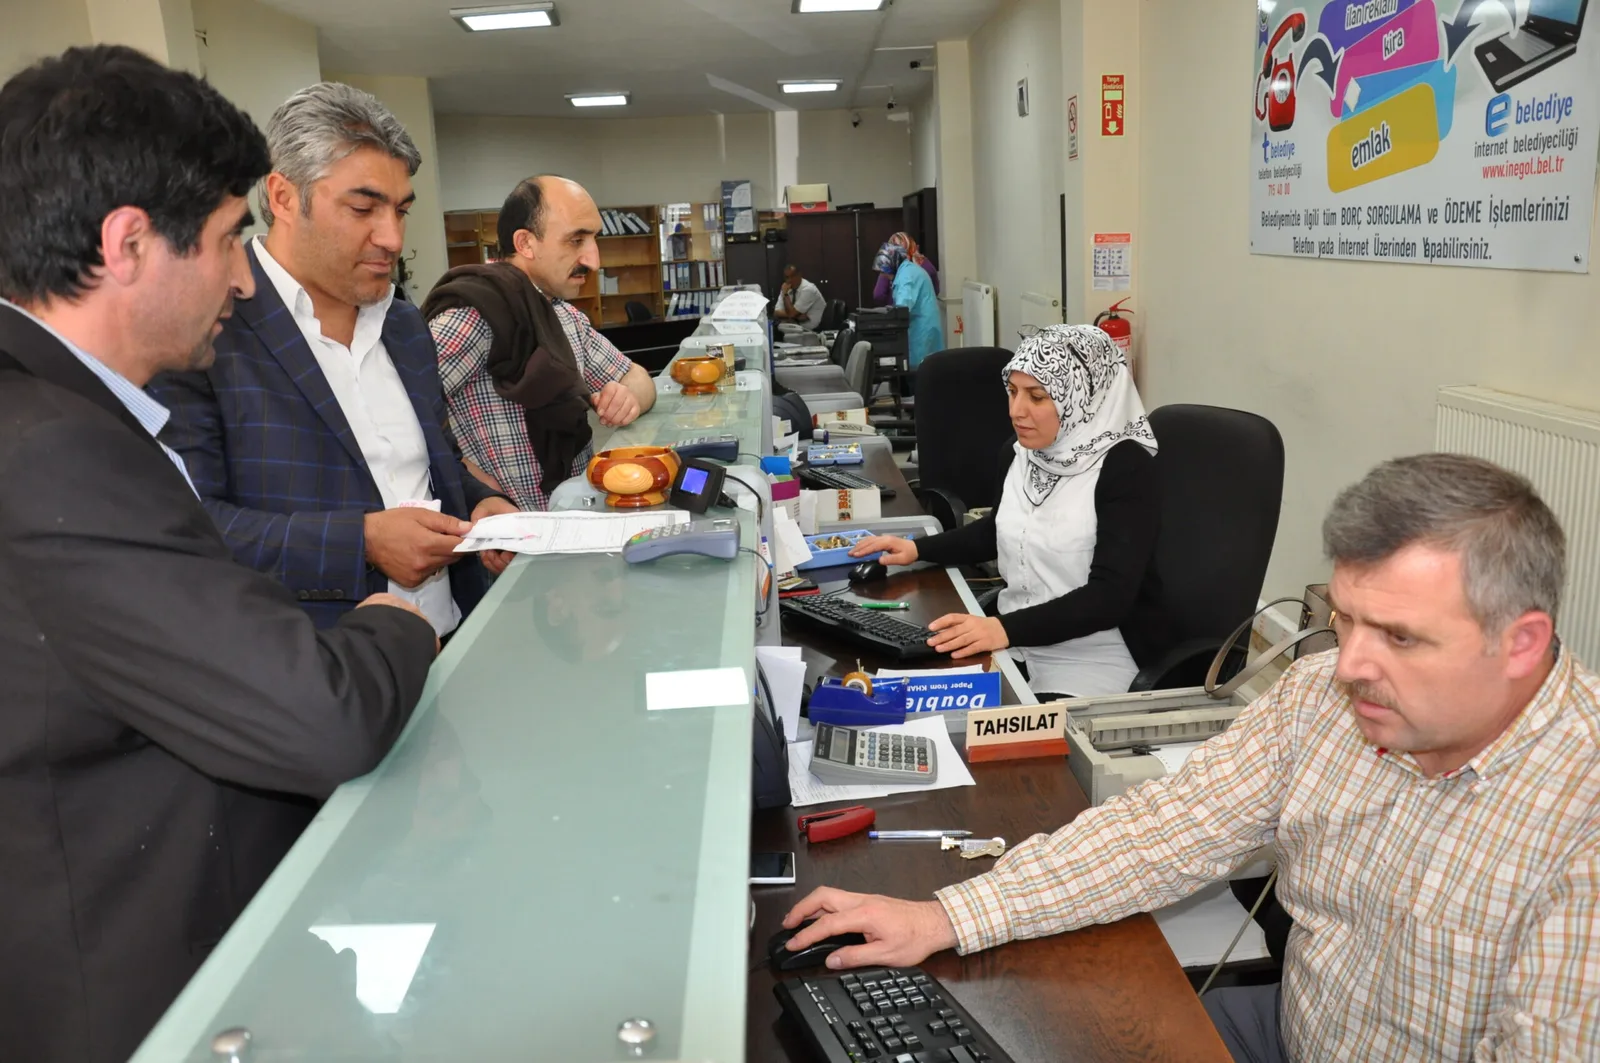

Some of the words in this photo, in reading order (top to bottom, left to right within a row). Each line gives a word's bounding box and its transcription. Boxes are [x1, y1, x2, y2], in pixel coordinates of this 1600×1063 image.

[1346, 5, 1362, 28] ilan
[1363, 0, 1398, 24] reklam
[1384, 30, 1404, 58] kira
[1485, 92, 1512, 138] e
[1515, 92, 1573, 125] belediye
[1270, 140, 1295, 160] belediye
[1352, 121, 1391, 169] emlak
[1474, 138, 1508, 158] internet
[1513, 126, 1579, 155] belediyeciliği
[1482, 155, 1564, 180] www.inegol.bel.tr
[1261, 209, 1301, 231] Belediyemizle
[1304, 208, 1320, 231] ilgili
[1323, 208, 1337, 226] tüm
[1341, 206, 1362, 230] BORÇ
[1366, 203, 1422, 226] SORGULAMA
[1427, 207, 1438, 224] ve
[1444, 197, 1482, 224] ÖDEME
[1488, 194, 1570, 229] İşlemlerinizi
[1293, 236, 1315, 254] Telefon
[1318, 237, 1334, 258] yada
[1338, 232, 1369, 256] İnternet
[1374, 233, 1417, 258] Üzerinden
[1422, 236, 1492, 263] Yapabilirsiniz.
[950, 682, 973, 690] Paper
[905, 693, 987, 713] Double
[974, 712, 1059, 736] TAHSILAT
